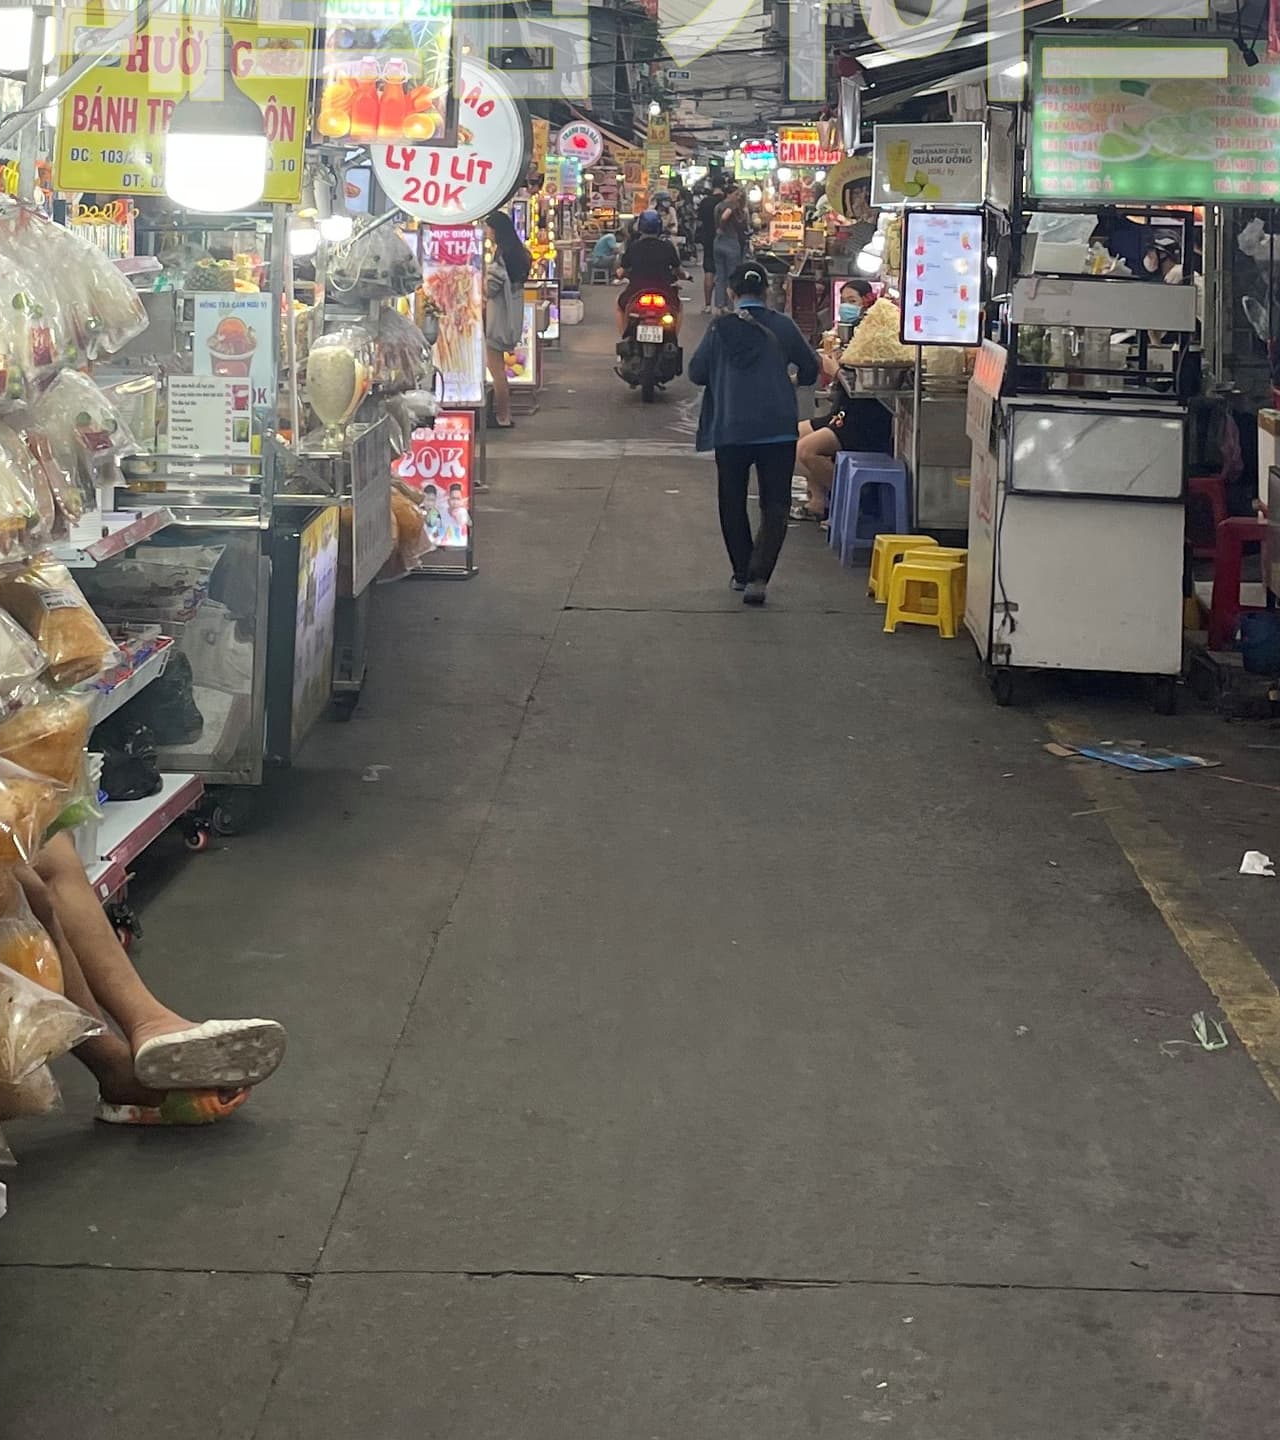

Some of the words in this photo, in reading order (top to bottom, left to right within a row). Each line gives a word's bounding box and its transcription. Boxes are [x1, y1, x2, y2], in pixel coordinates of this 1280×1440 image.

[125, 26, 253, 78] HƯỜG
[72, 86, 138, 135] BÁNH
[385, 144, 417, 172] LY
[429, 151, 440, 177] 1
[450, 152, 493, 185] LÍT
[403, 177, 467, 212] 20K
